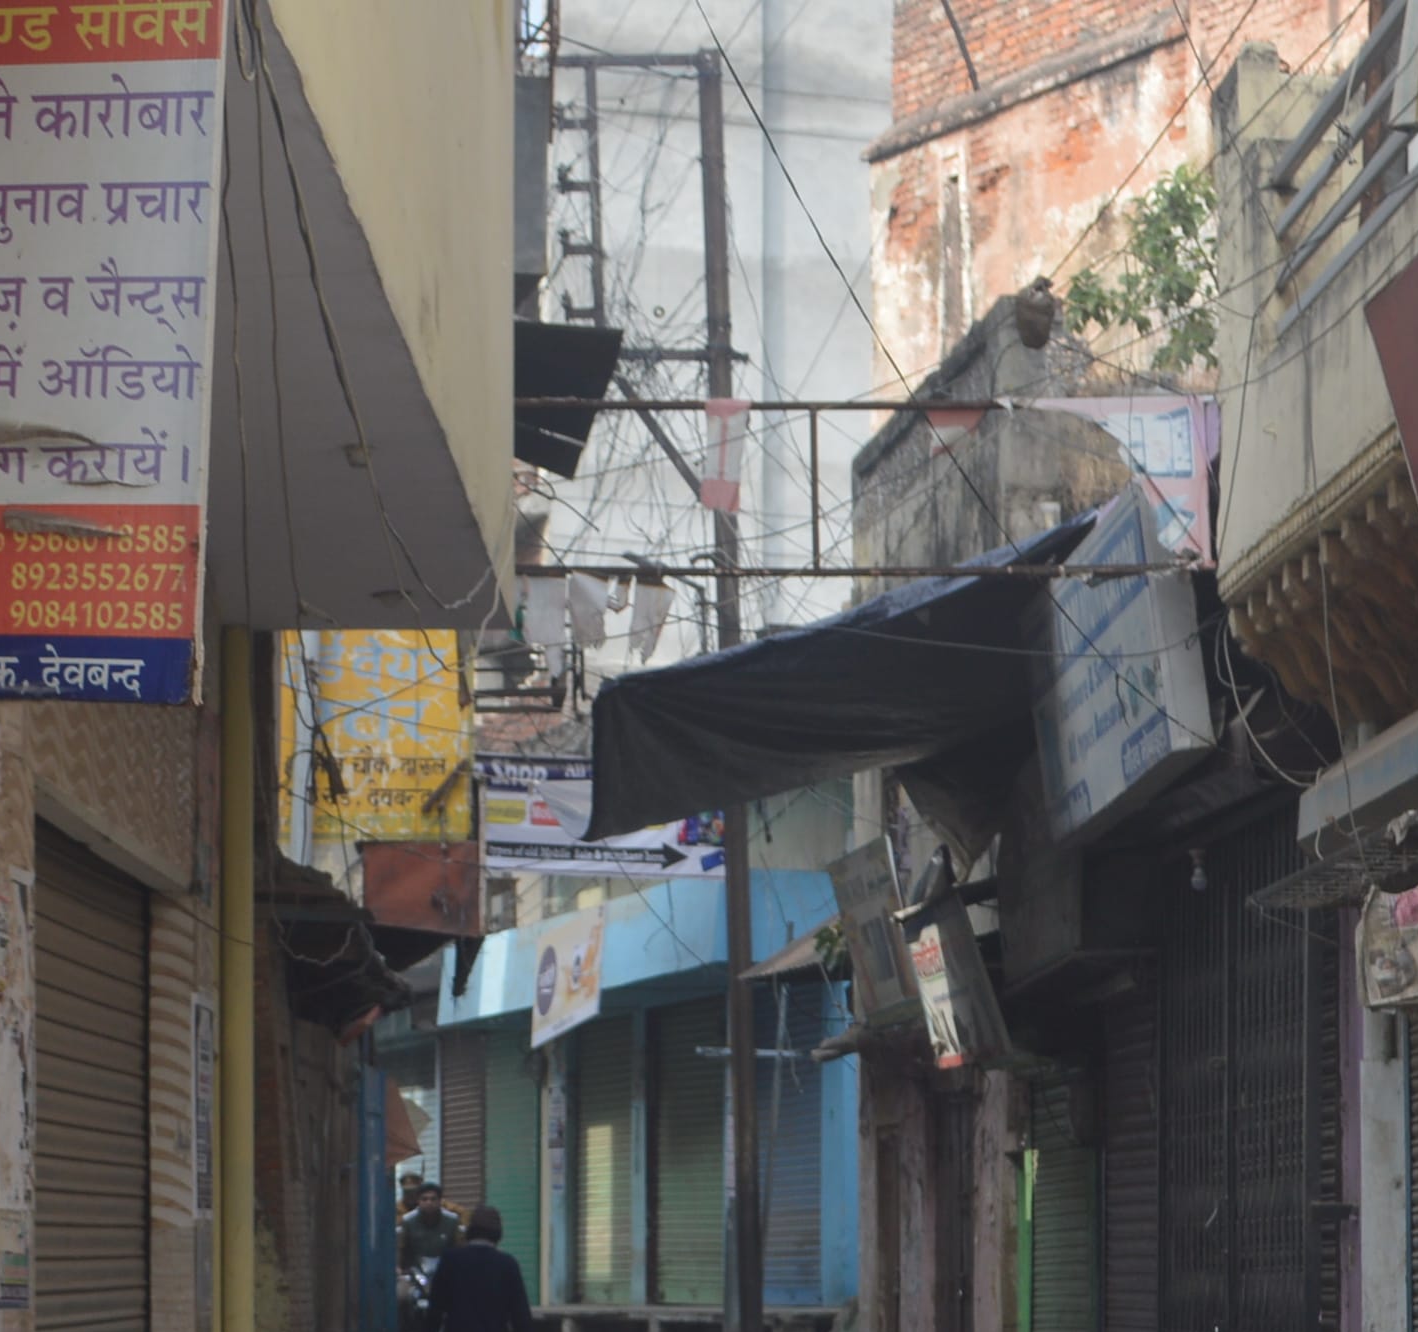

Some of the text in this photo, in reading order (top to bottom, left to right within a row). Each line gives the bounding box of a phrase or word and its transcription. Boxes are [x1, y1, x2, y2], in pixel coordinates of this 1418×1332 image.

[31, 73, 214, 140] कारोबार
[100, 181, 211, 226] प्रचार
[38, 276, 74, 317] व
[86, 257, 207, 335] जैन्ट्स
[37, 344, 203, 401] ऑडियो
[10, 562, 186, 593] 8923552677
[9, 600, 183, 632] 9084102585
[39, 643, 146, 698] देवबन्द
